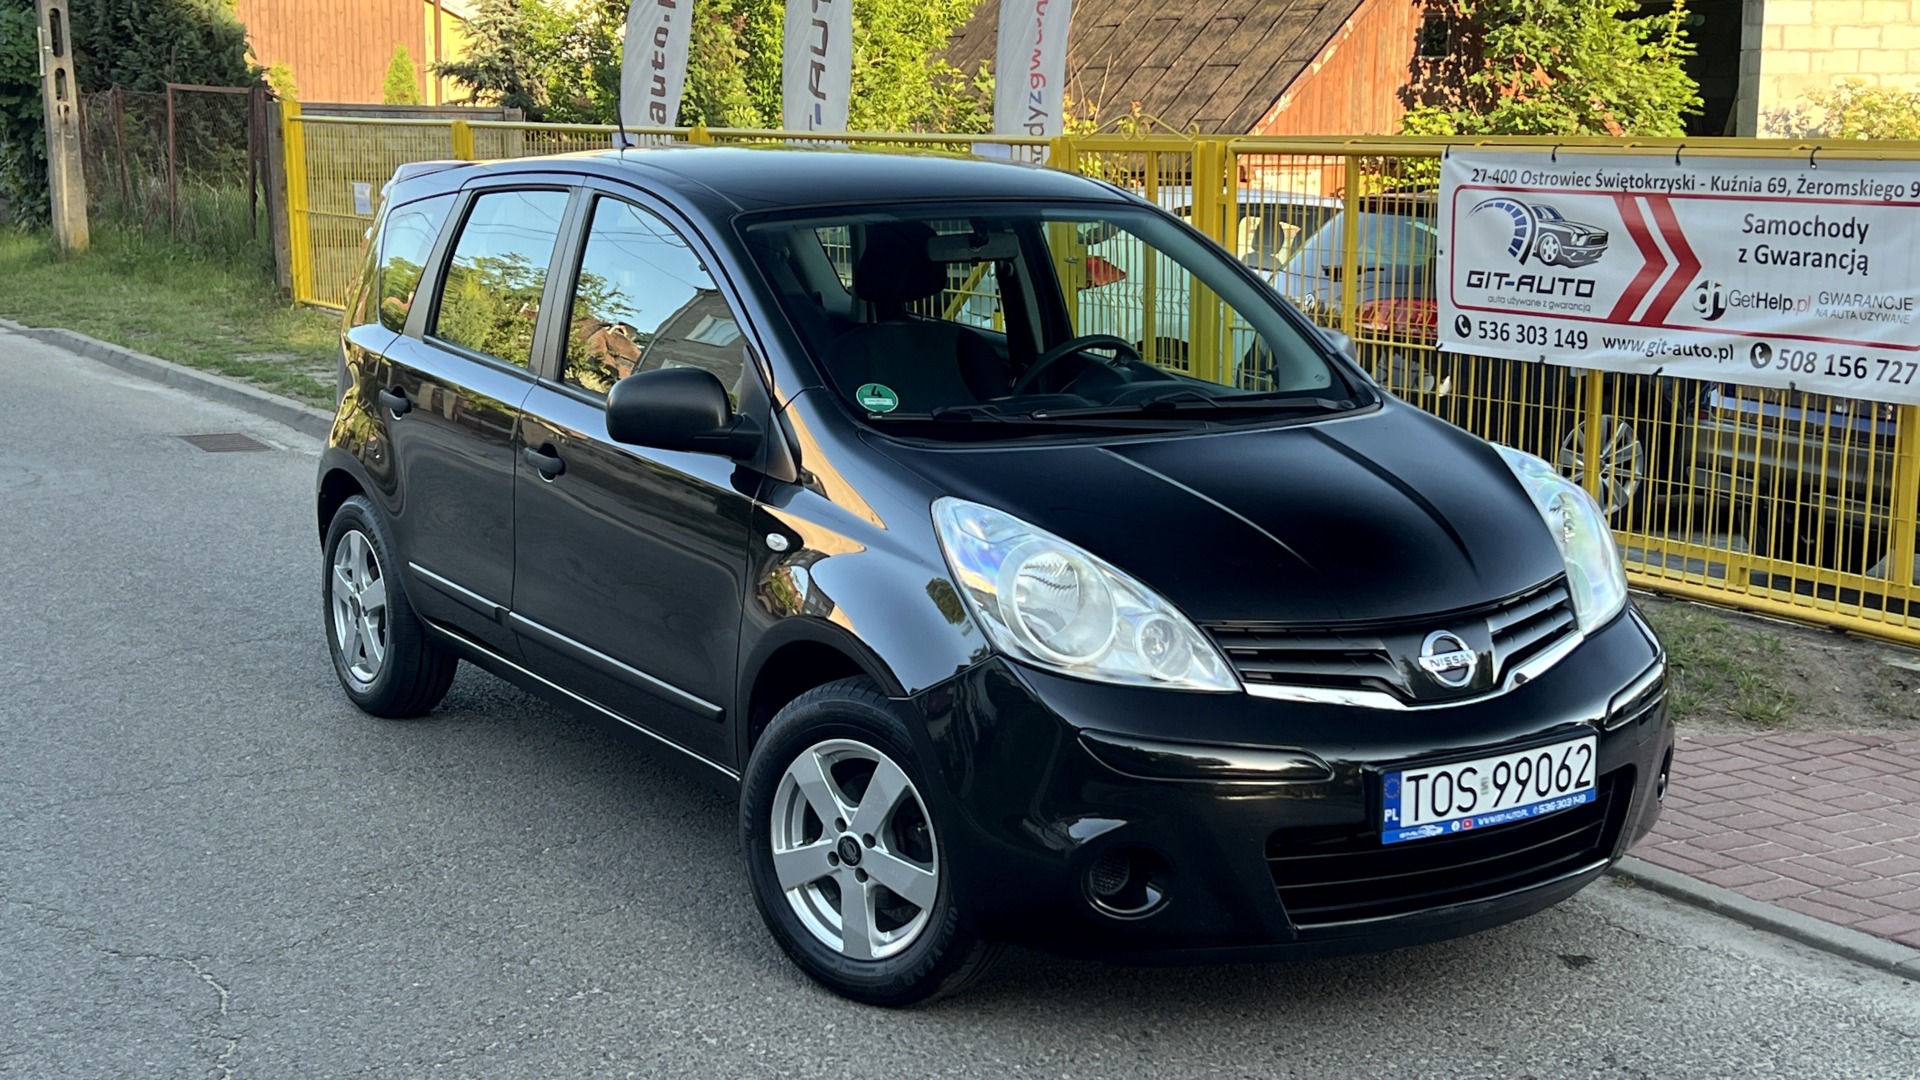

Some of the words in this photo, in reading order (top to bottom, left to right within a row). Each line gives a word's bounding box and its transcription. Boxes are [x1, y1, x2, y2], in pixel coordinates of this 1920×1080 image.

[1471, 168, 1517, 185] 27-400
[1520, 170, 1591, 187] Ostrowiec
[1595, 168, 1696, 194] Świętokrzyski
[1710, 174, 1762, 193] Kuźnia
[1767, 177, 1792, 197] 69,
[1796, 174, 1905, 201] Żeromskiego
[1742, 213, 1870, 244] Samochody
[1738, 247, 1748, 263] z
[1754, 245, 1869, 276] Gwarancją
[1466, 270, 1596, 298] GIT-AUTO
[1487, 295, 1506, 304] auta
[1542, 300, 1547, 308] z
[1548, 300, 1591, 313] gwarancją
[1728, 289, 1812, 315] GetHelp.pl
[1814, 308, 1829, 318] NA
[1830, 309, 1858, 320] AUTA
[1818, 291, 1914, 311] GWARANCJE
[1478, 320, 1510, 342] 536
[1515, 323, 1548, 346] 303
[1554, 328, 1589, 350] 149
[1602, 337, 1734, 363] www.git-auto.pl
[1776, 348, 1818, 374] 508
[1824, 354, 1868, 379] 156
[1876, 358, 1919, 385] 727
[1429, 653, 1473, 668] NISSAN
[1406, 766, 1479, 822] TOS
[1491, 743, 1593, 809] 99062
[1384, 807, 1399, 823] PL
